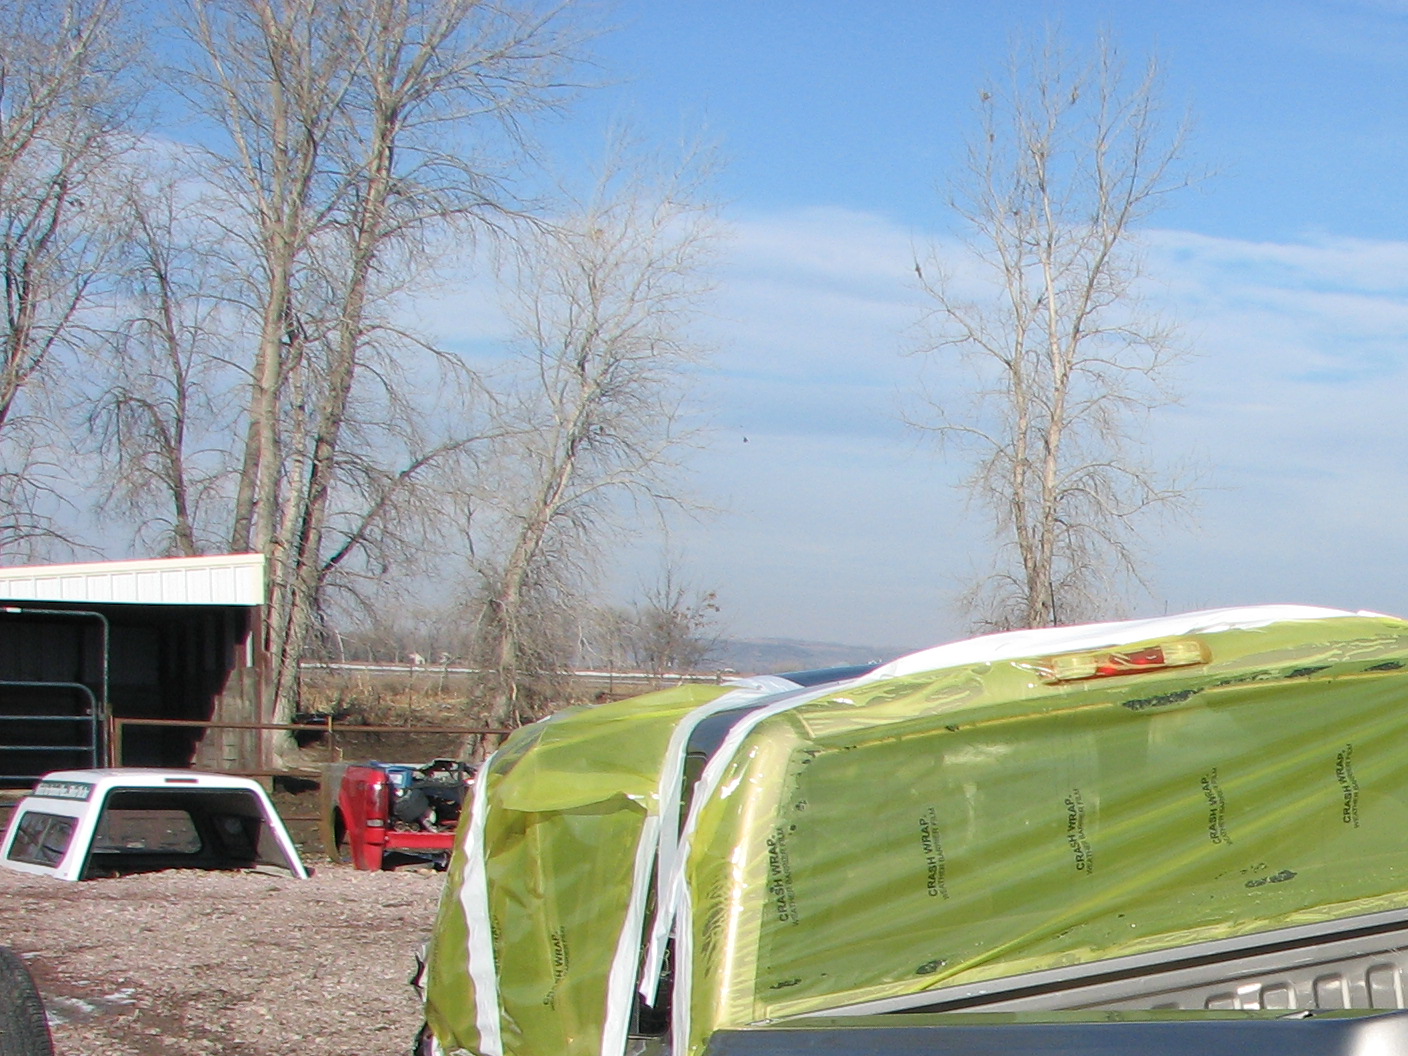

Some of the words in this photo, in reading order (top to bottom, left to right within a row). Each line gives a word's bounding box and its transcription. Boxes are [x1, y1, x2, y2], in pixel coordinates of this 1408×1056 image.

[1342, 785, 1353, 823] CRASH
[1209, 808, 1222, 845] CRASH
[1067, 834, 1085, 870] CRASH
[927, 856, 938, 897] CRASH
[774, 878, 788, 921] CRASH
